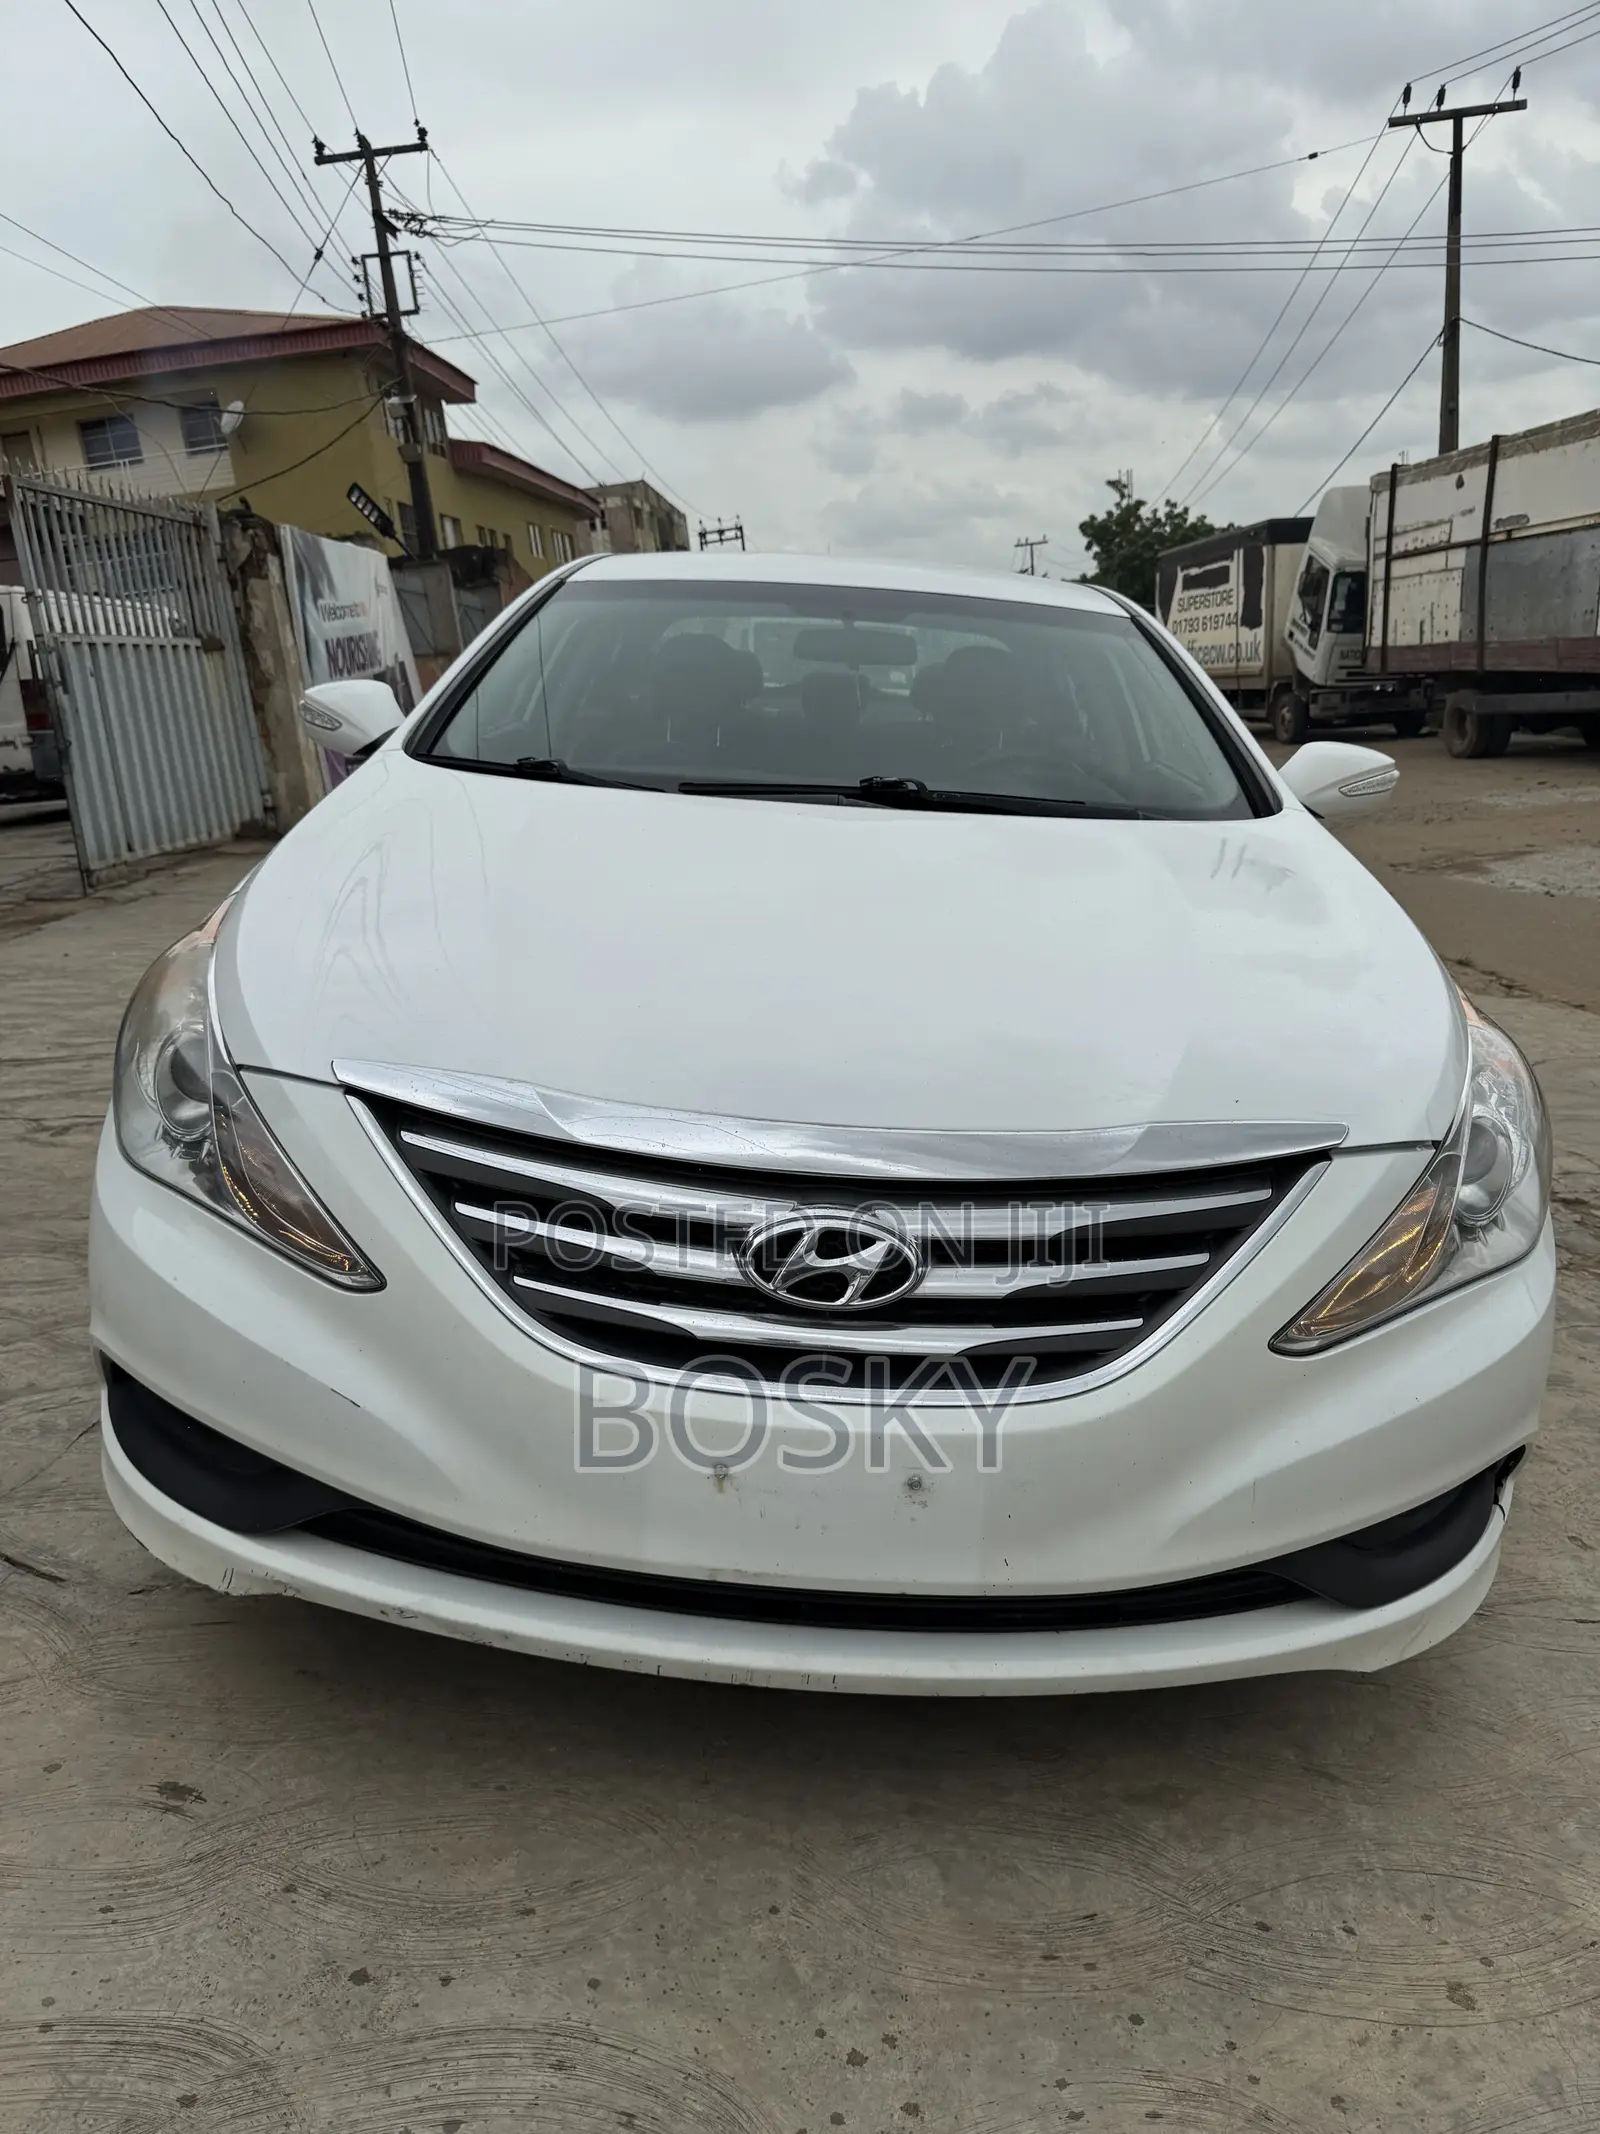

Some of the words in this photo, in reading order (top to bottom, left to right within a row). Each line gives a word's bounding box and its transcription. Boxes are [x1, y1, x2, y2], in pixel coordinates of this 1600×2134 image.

[1177, 588, 1234, 613] SUPERSTORE
[1172, 617, 1200, 636] 01793
[1201, 611, 1238, 633] 619744
[325, 630, 383, 680] NOURIS
[1185, 631, 1262, 666] fficecw.co.uk
